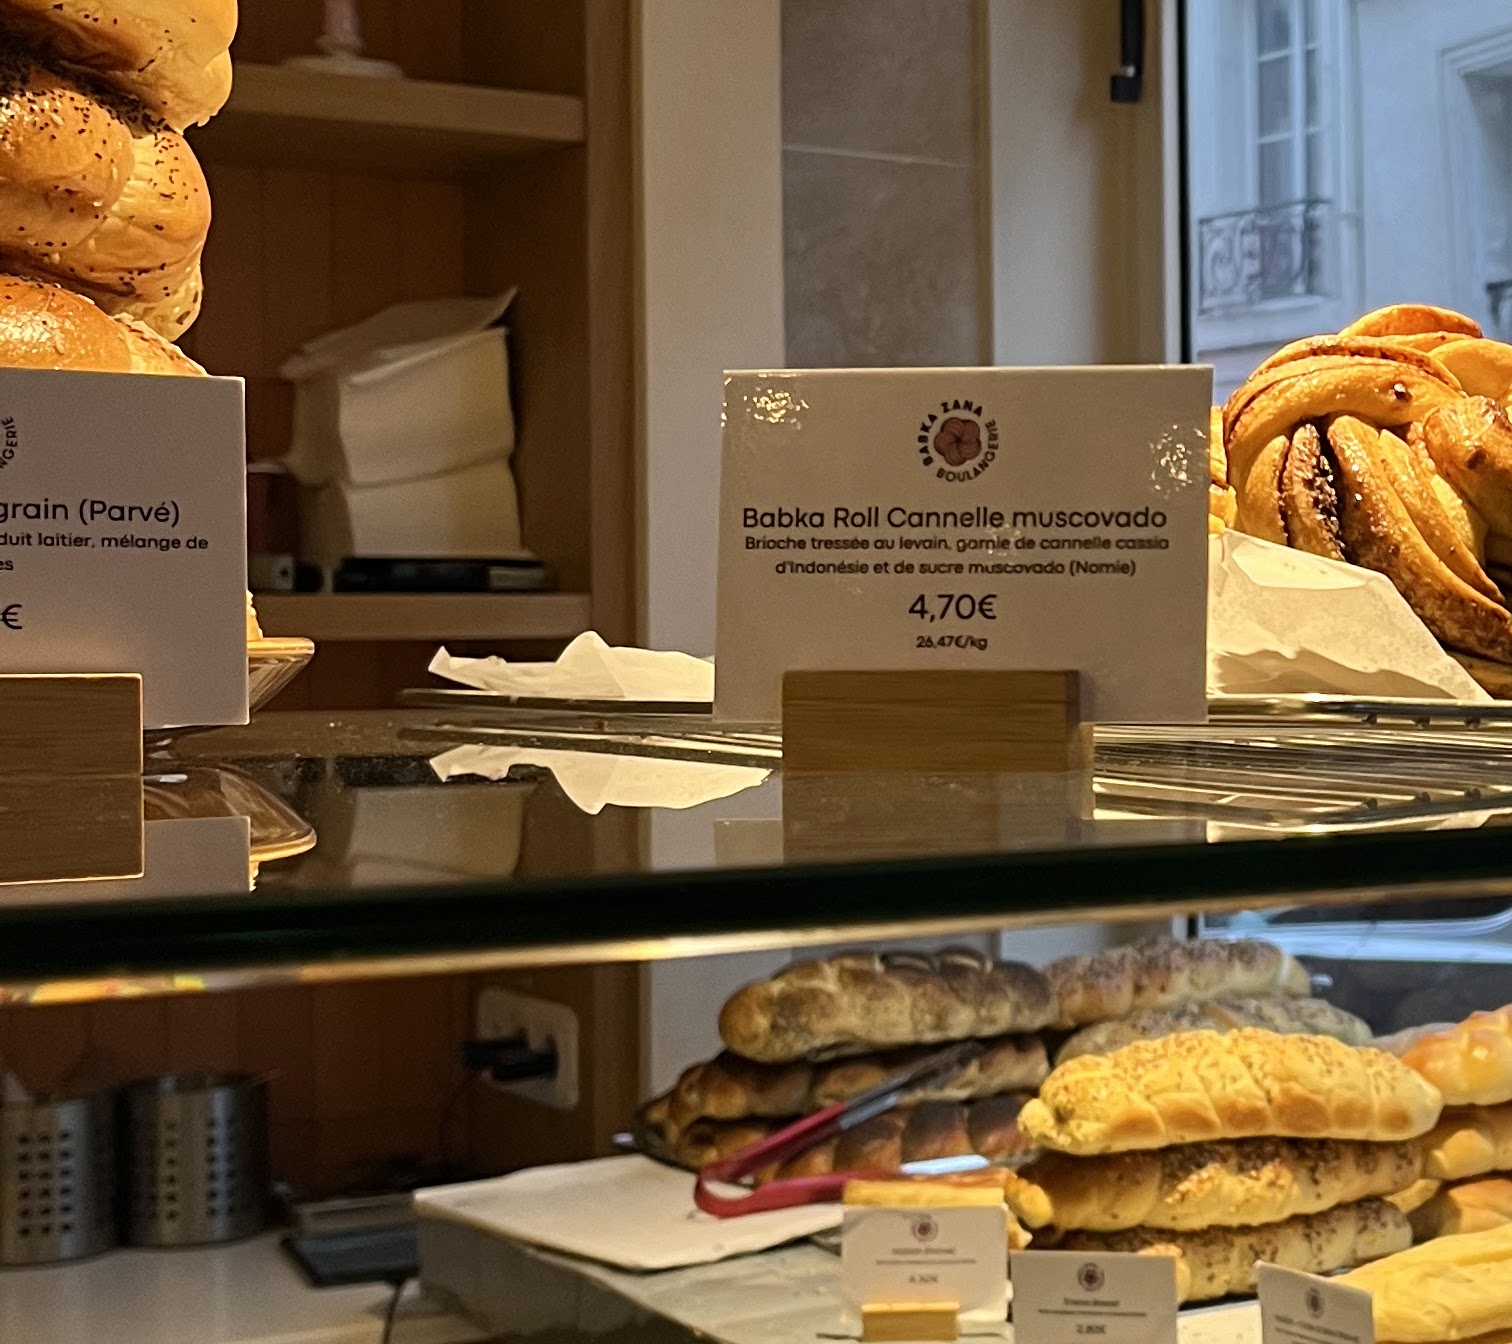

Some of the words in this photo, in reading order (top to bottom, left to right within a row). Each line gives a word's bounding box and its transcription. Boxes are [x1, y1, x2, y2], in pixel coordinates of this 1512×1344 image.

[941, 399, 983, 417] ZANA
[79, 498, 181, 527] (Parvé)
[743, 507, 825, 528] Babka
[834, 507, 879, 528] Roll
[887, 506, 1005, 528] Cannelle
[1012, 507, 1168, 528] muscovado
[38, 532, 96, 549] laitier,
[101, 534, 181, 552] mélange
[186, 536, 209, 550] de
[745, 535, 807, 550] Brioche
[811, 536, 870, 550] tressée
[874, 539, 895, 550] au
[899, 535, 952, 551] levain,
[956, 537, 1010, 553] garnie
[1015, 536, 1036, 550] de
[1040, 536, 1112, 550] cannelle
[1115, 537, 1170, 550] cassia
[775, 560, 869, 574] d'Indonésie
[873, 561, 890, 574] et
[894, 561, 915, 574] de
[918, 563, 964, 574] sucre
[968, 561, 1065, 574] muscovado
[1069, 560, 1136, 577] (Nomie)
[908, 593, 997, 623] 4,70€
